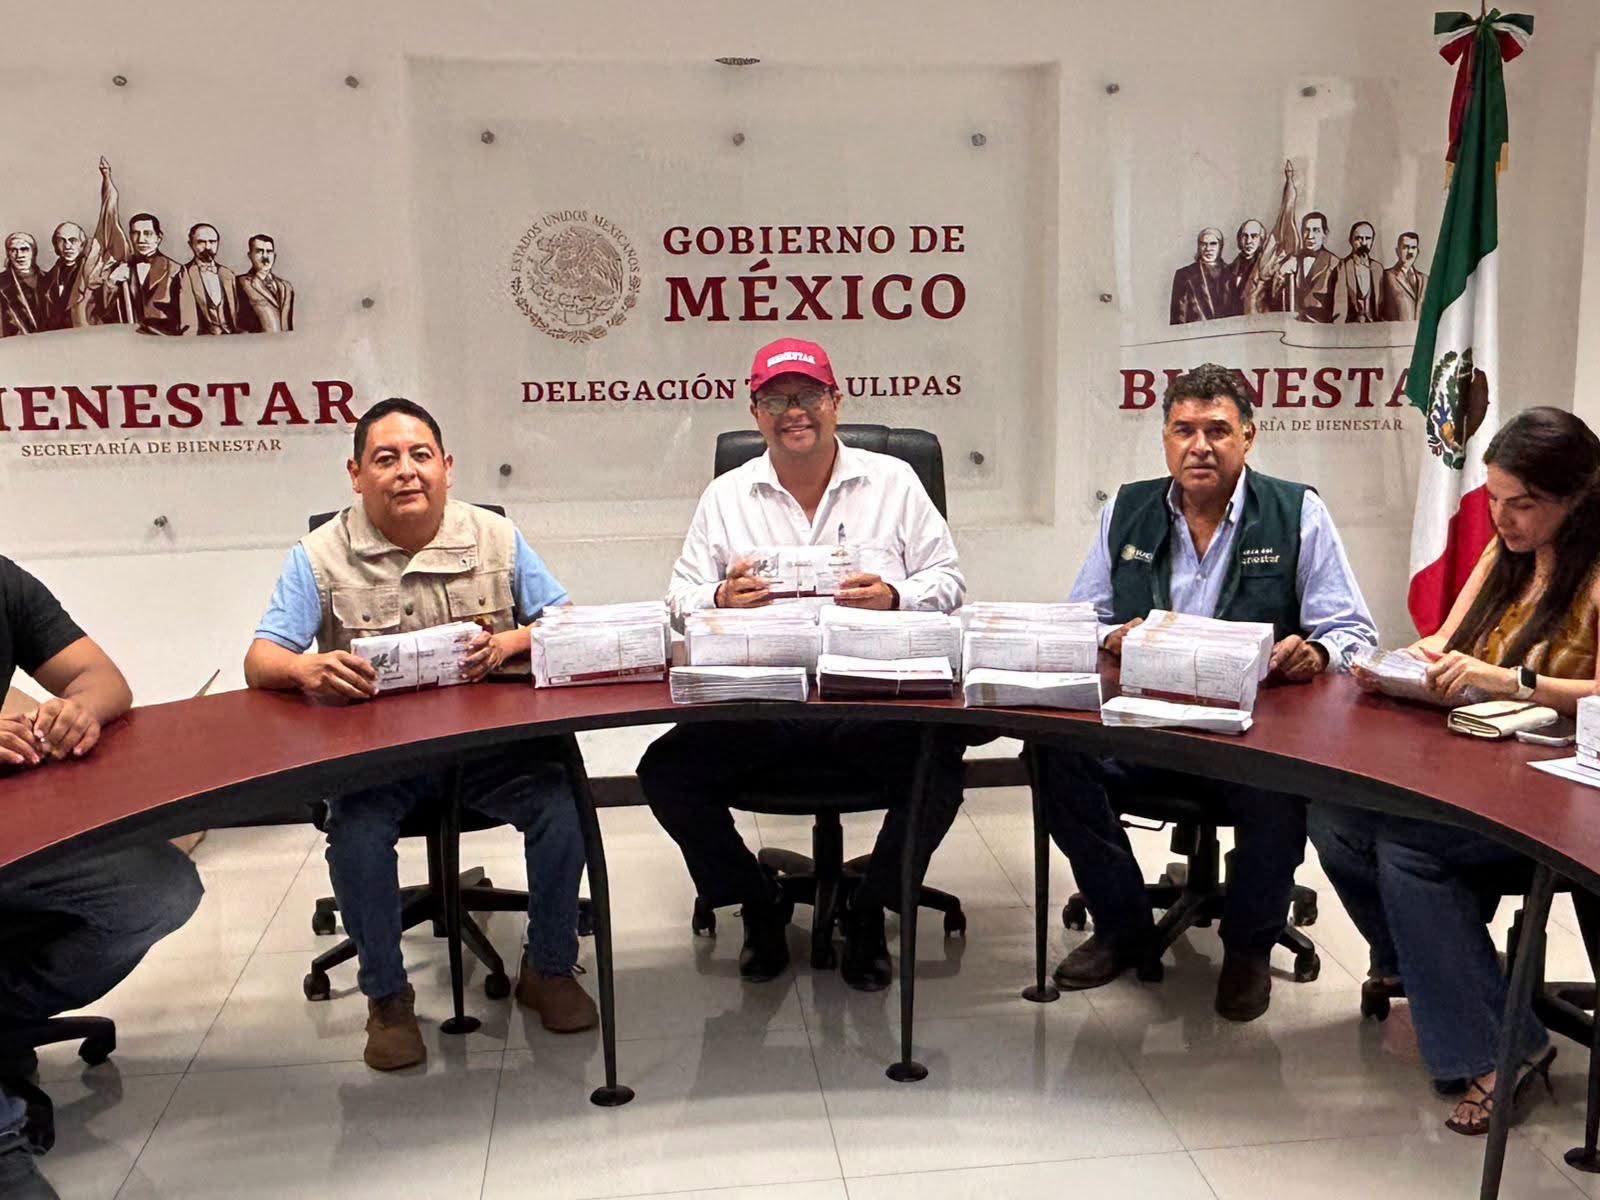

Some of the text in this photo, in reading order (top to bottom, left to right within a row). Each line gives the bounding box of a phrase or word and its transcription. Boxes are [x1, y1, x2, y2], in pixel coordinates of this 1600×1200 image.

[511, 209, 641, 274] ESTADOS UNIDOS MEXICANOS
[663, 225, 965, 256] GOBIERNO DE
[664, 258, 966, 322] MÉXICO
[521, 373, 735, 403] DELEGACIÓN
[0, 380, 360, 432] ENESTAR
[1292, 419, 1312, 431] DE
[1316, 416, 1405, 431] BIENESTAR
[21, 437, 282, 457] SECRETARÍA DE BIENESTAR
